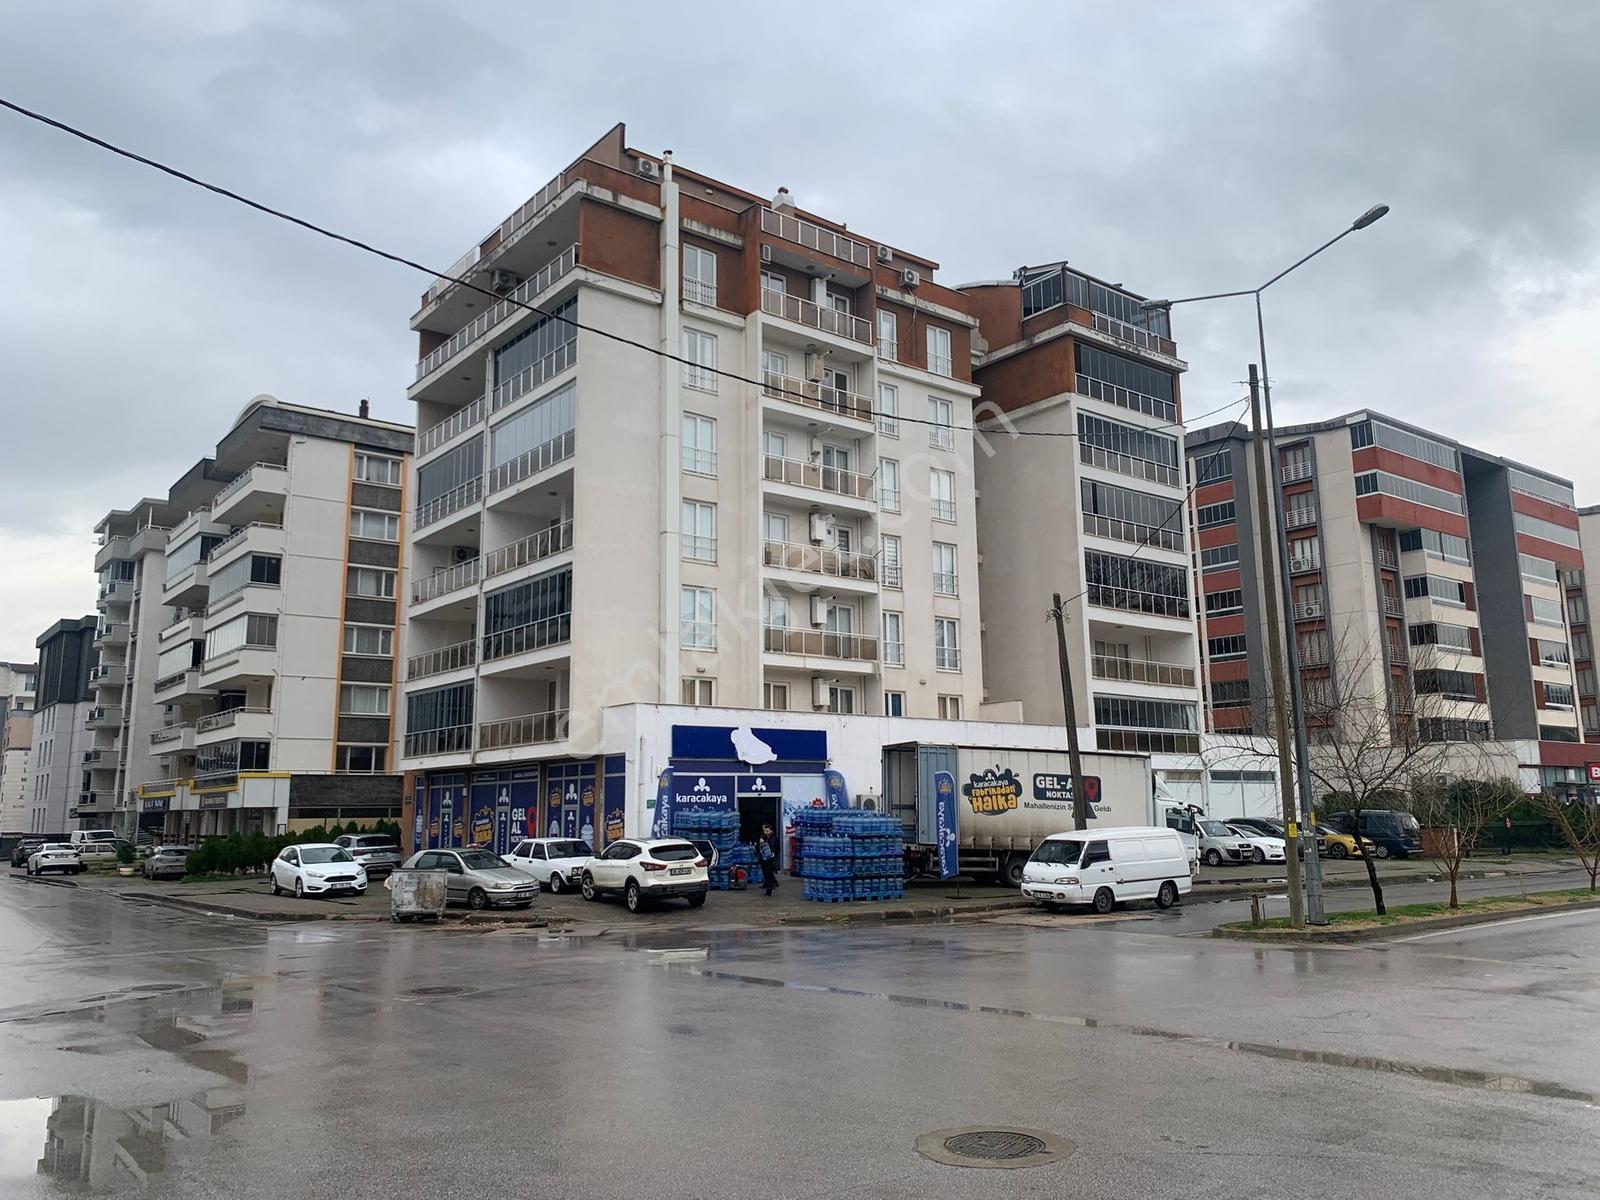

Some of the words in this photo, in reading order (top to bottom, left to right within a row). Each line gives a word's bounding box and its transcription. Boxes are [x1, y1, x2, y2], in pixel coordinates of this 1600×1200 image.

[1035, 776, 1074, 789] GEL-A
[675, 792, 727, 804] karacakaya
[1023, 801, 1067, 811] Mahallenizin
[1093, 804, 1112, 812] Geldi
[511, 808, 527, 821] GEL
[660, 794, 670, 837] cakaya
[511, 821, 522, 834] AL
